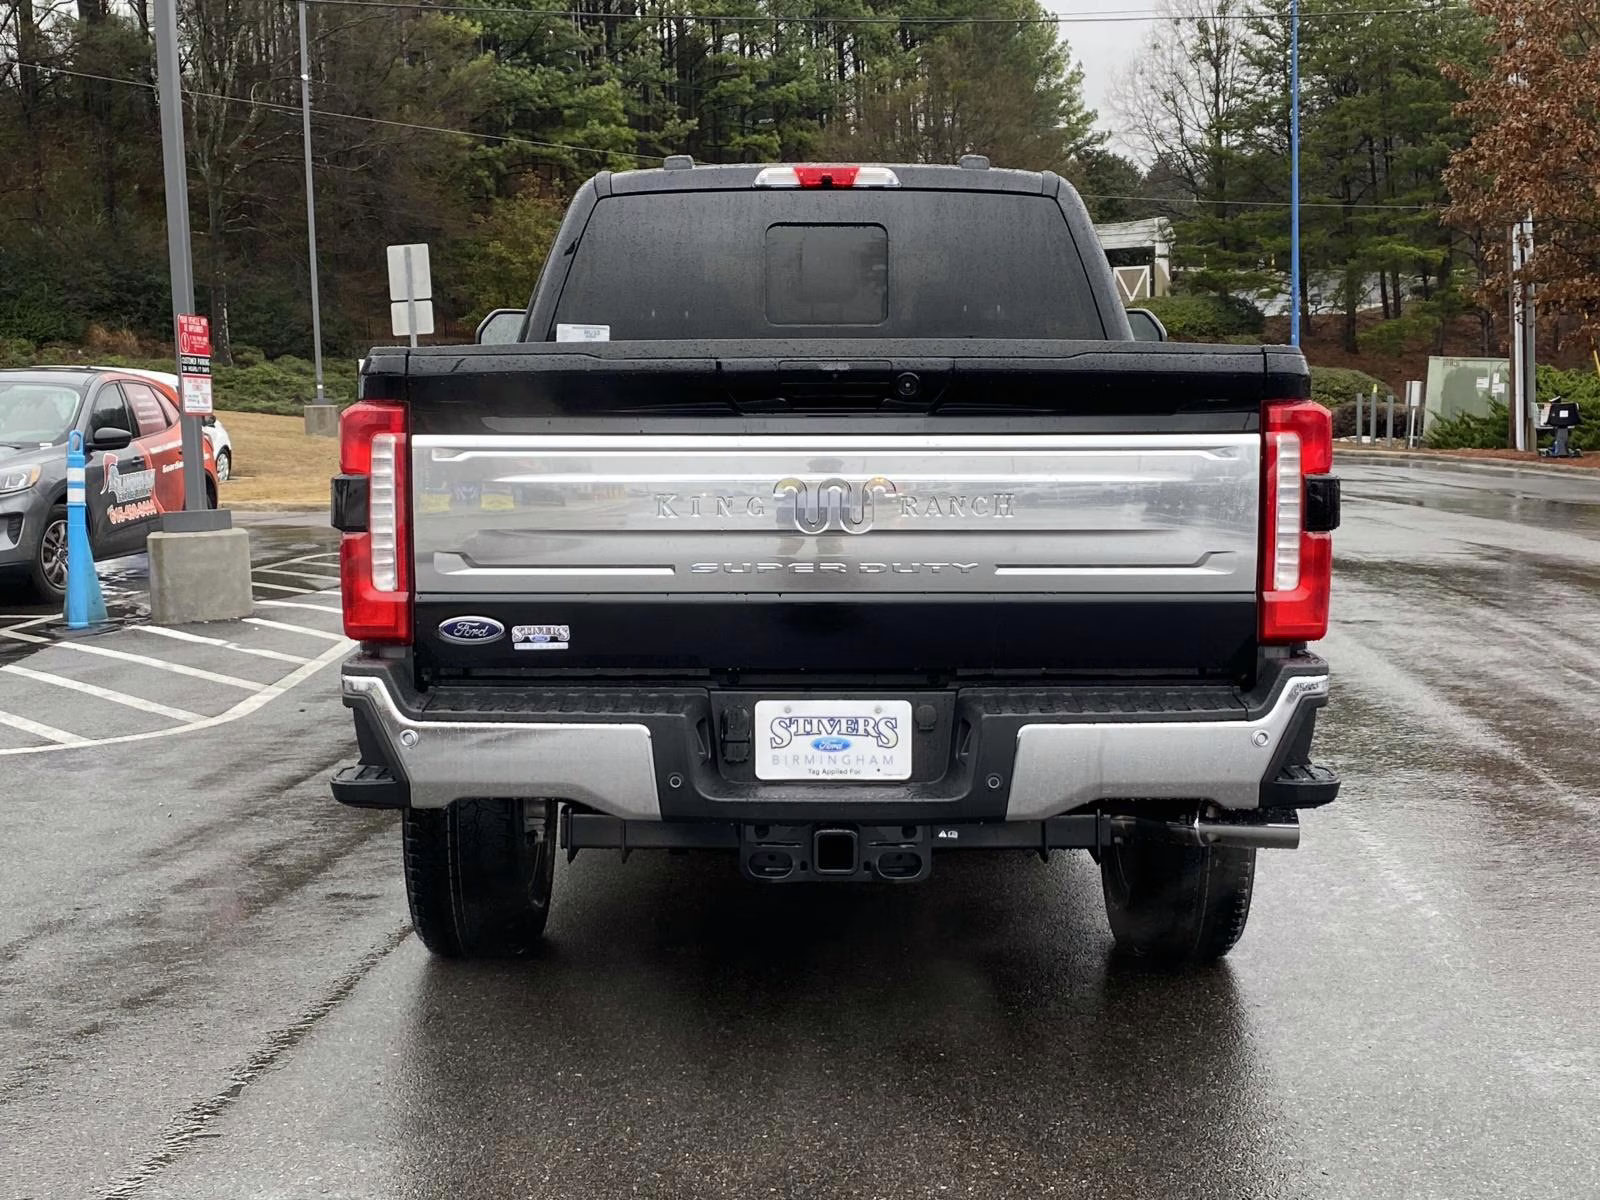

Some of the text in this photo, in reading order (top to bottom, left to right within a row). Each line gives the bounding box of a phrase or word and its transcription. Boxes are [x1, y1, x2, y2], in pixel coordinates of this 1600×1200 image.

[655, 493, 1015, 519] KING RANCH
[691, 562, 979, 575] SUPER DUTY
[453, 621, 489, 637] Ford
[770, 716, 898, 749] STIVERS
[771, 754, 894, 766] BIRMINGHAM
